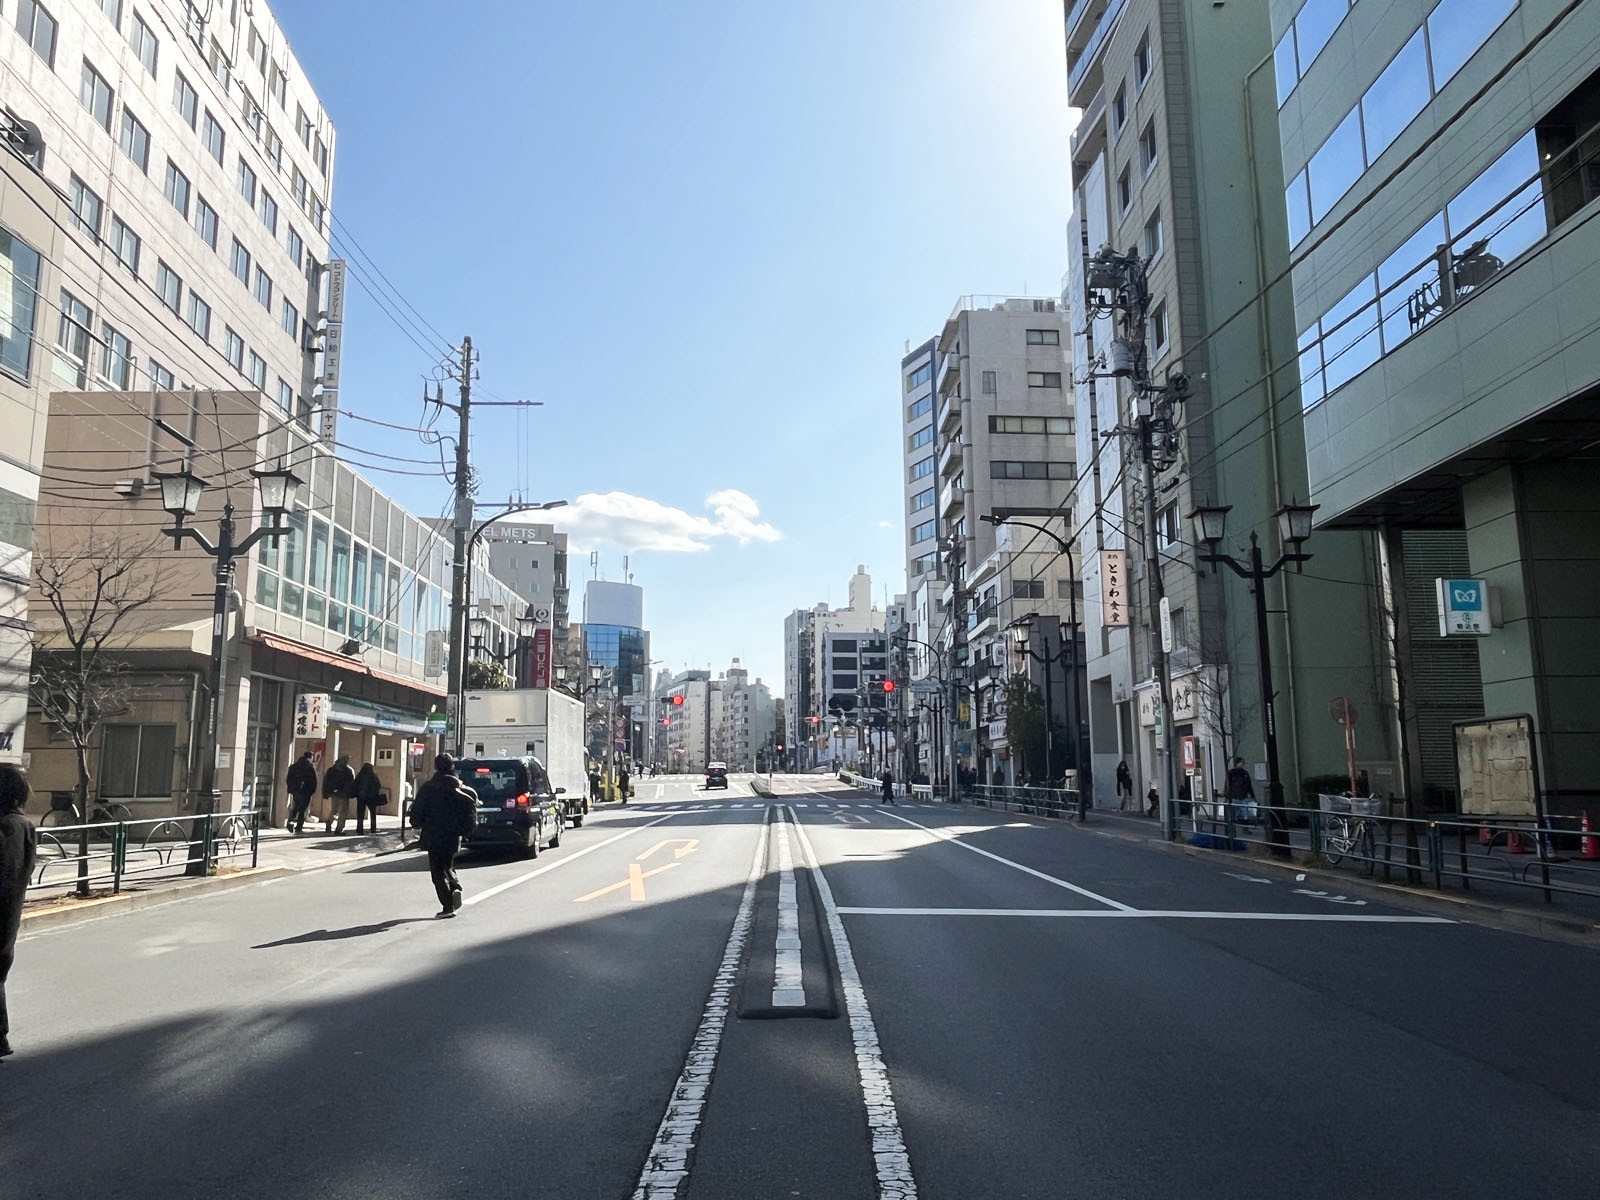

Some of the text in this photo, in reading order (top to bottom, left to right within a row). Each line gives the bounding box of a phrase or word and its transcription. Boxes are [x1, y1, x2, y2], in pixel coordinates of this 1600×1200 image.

[501, 527, 536, 539] METS
[1108, 563, 1121, 623] ときわ食堂
[312, 696, 321, 732] アパート
